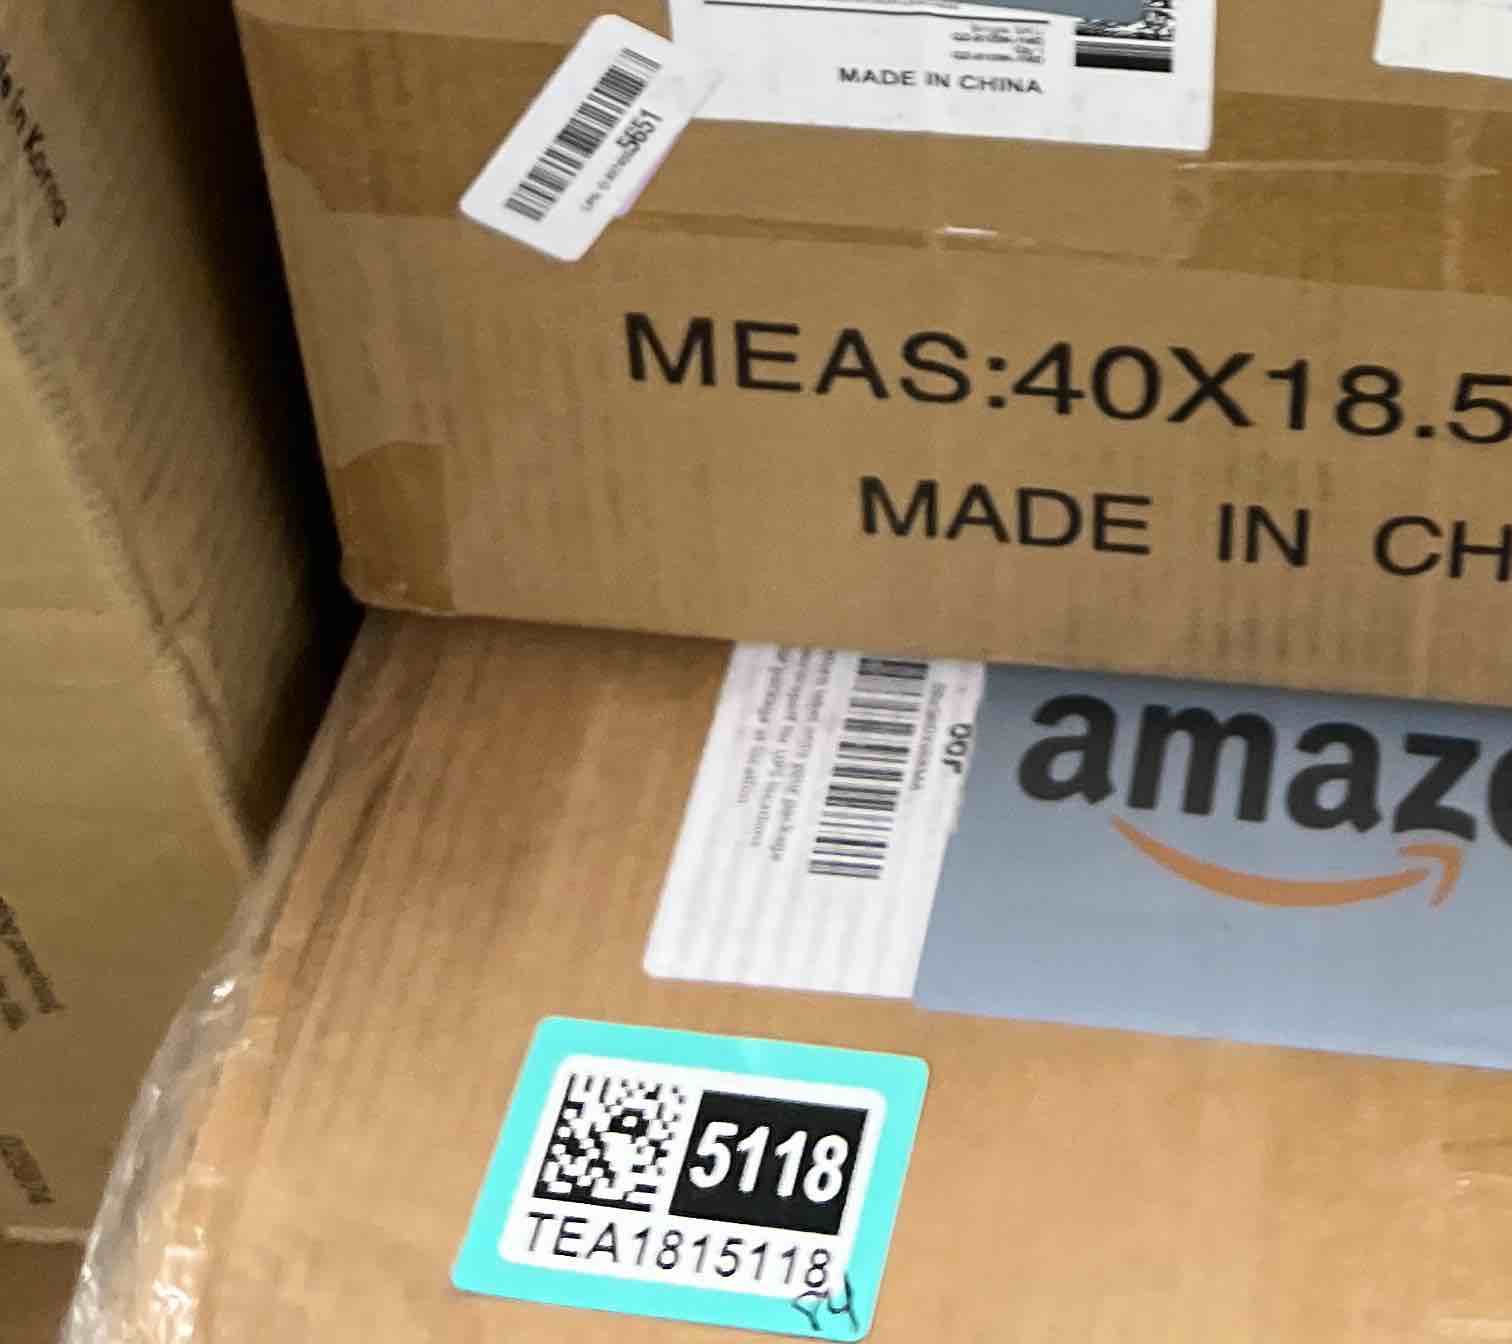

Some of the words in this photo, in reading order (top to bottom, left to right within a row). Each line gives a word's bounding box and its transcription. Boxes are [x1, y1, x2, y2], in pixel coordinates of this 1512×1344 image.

[838, 66, 915, 88] MADE
[926, 72, 952, 90] IN
[960, 76, 1044, 96] CHINA
[859, 476, 1152, 556] MADE
[1216, 502, 1310, 568] IN
[688, 1121, 849, 1203] 5118
[527, 1211, 832, 1289] TEA1815118
